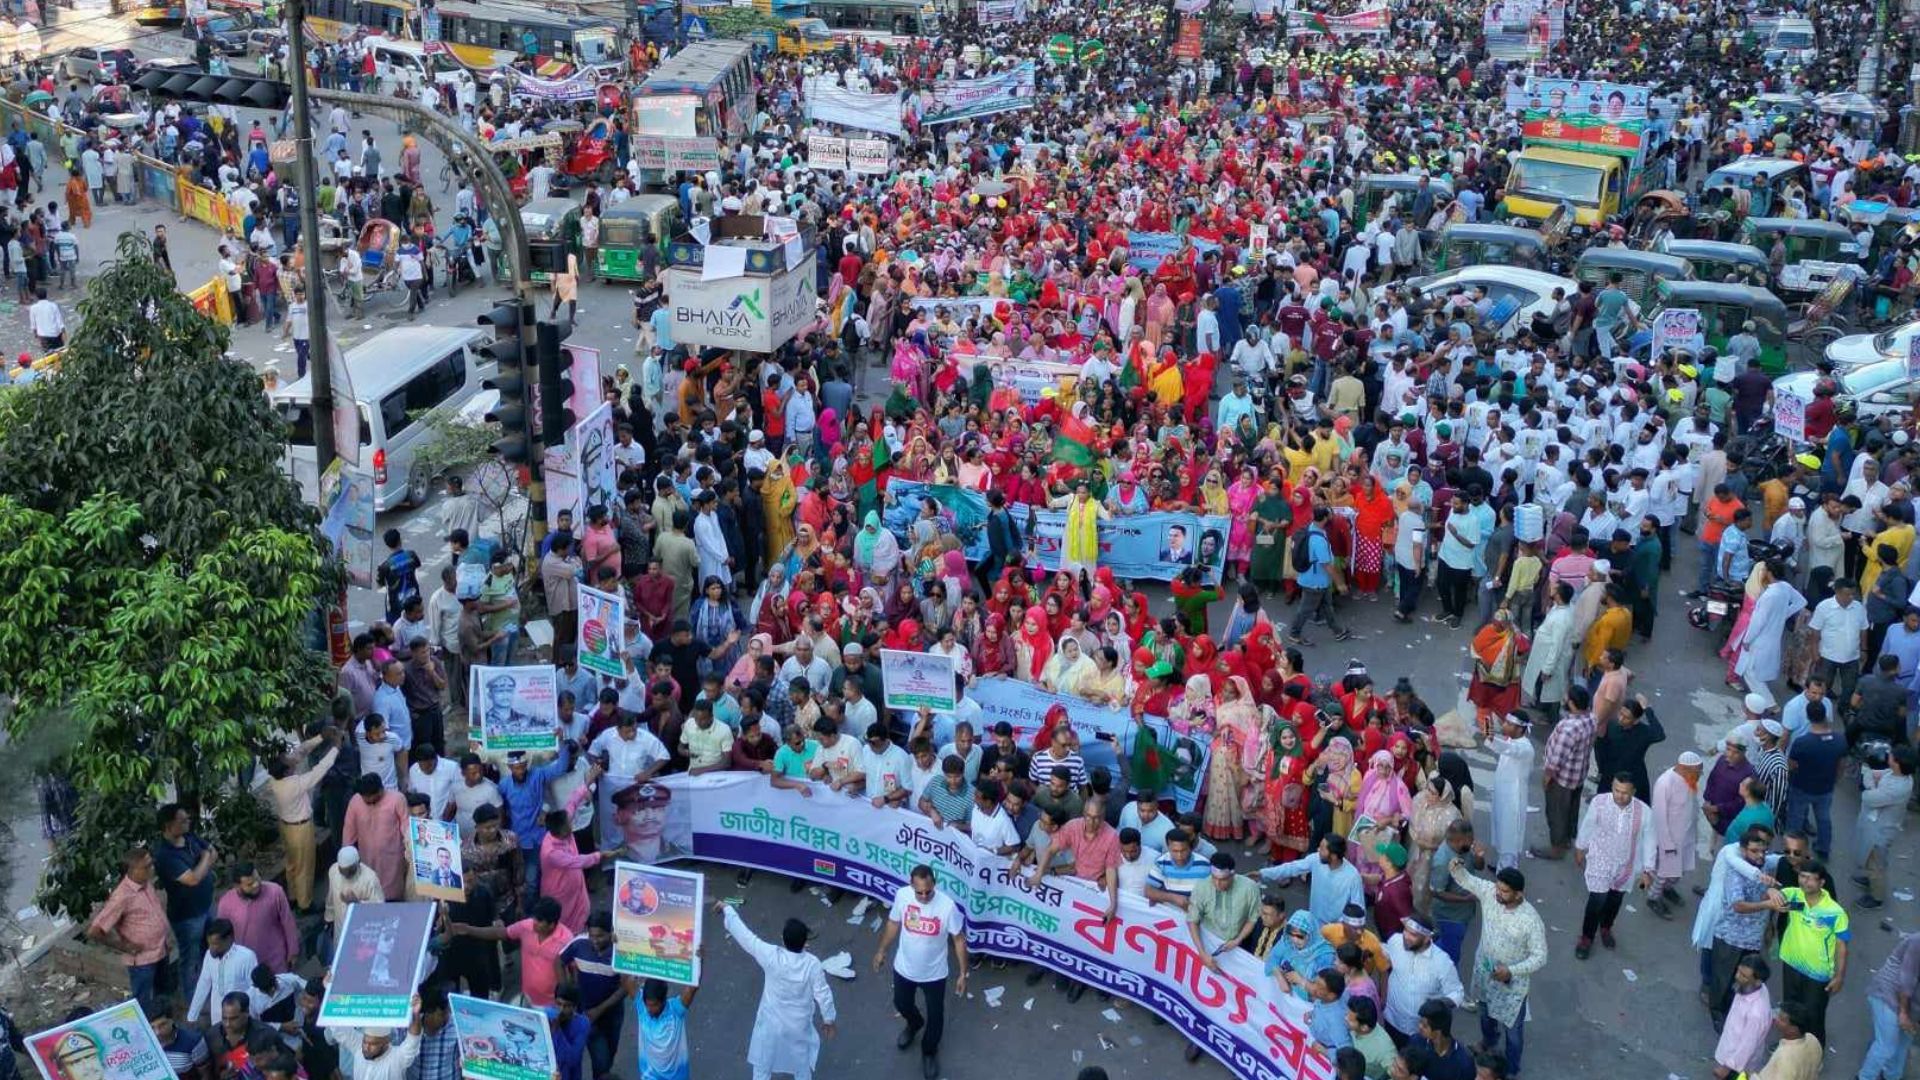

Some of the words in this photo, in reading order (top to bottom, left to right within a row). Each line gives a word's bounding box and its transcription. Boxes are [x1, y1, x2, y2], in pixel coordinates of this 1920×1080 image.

[676, 306, 751, 328] BHAIYA
[719, 807, 785, 840] জাতীয়
[790, 815, 841, 851] বিপ্লব
[845, 837, 860, 855] ও
[969, 888, 1061, 934] উপলক্ষে
[978, 867, 991, 886] ৭
